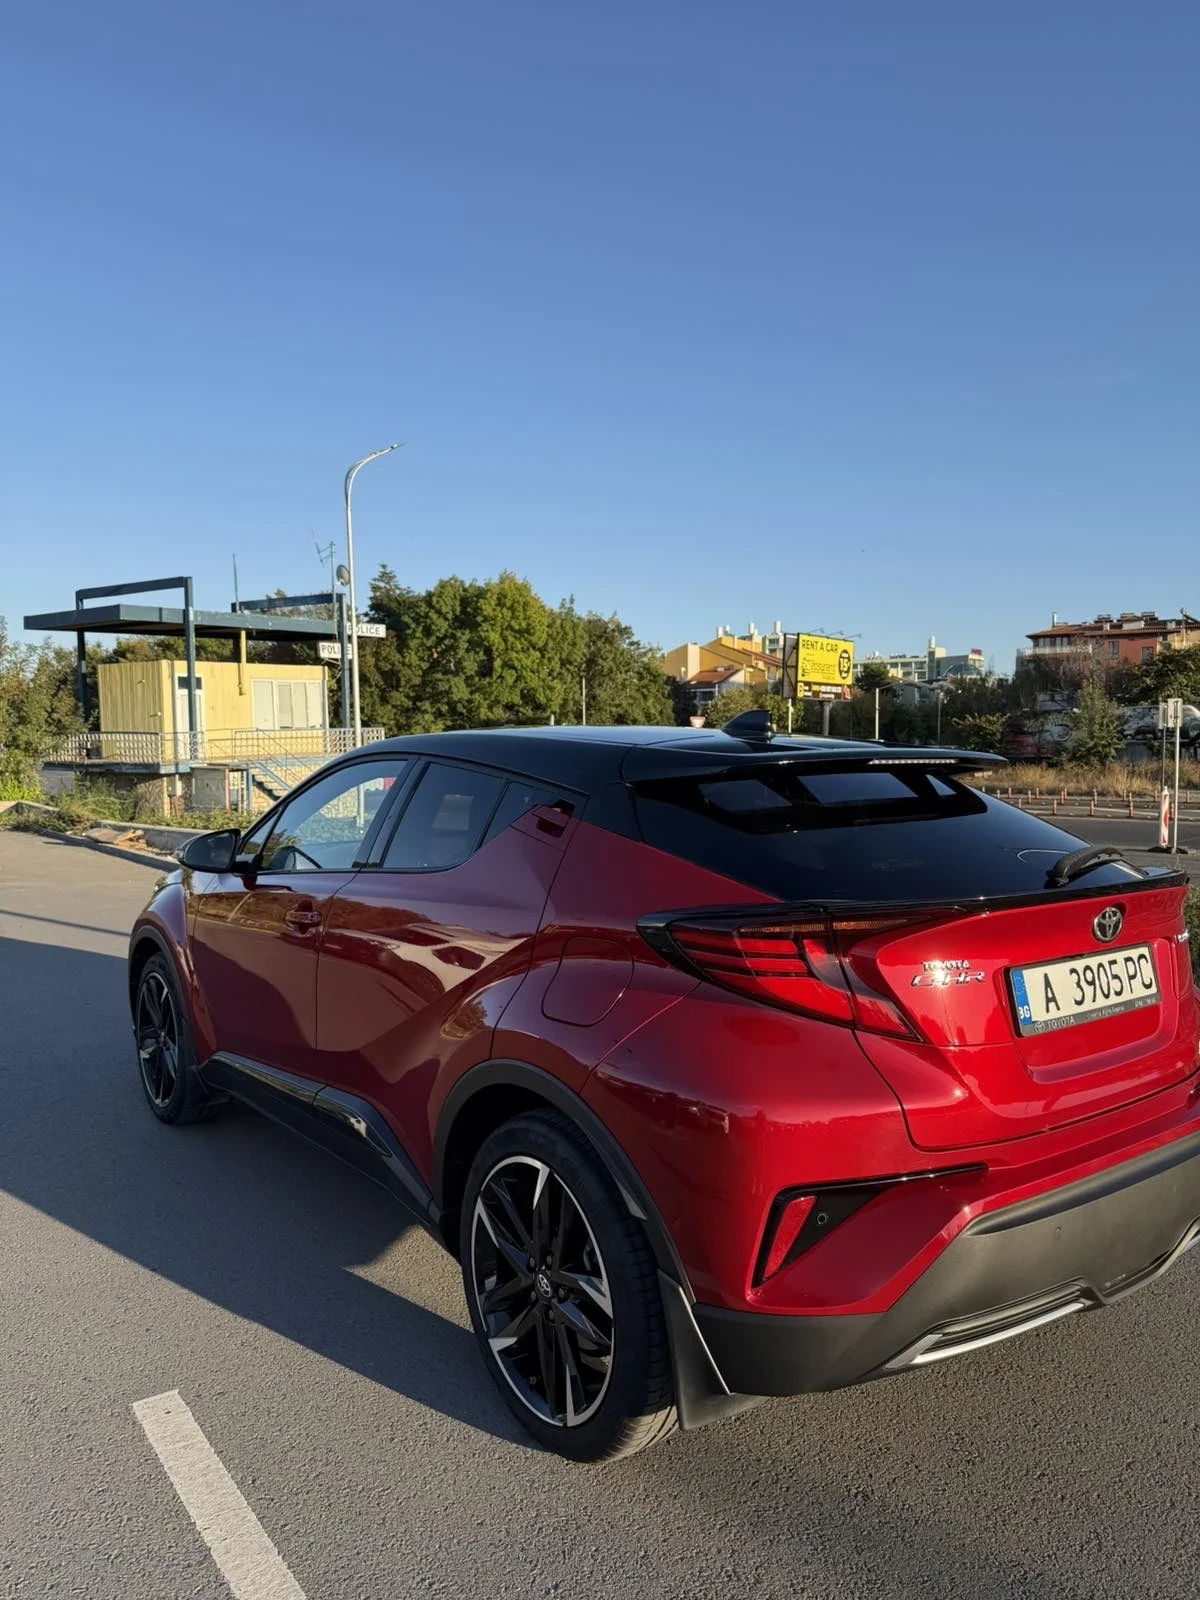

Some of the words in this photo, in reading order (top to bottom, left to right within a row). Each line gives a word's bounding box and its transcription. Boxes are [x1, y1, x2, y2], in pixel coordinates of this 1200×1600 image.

[321, 644, 351, 655] POLIE
[801, 639, 818, 650] RENT
[820, 642, 825, 651] A
[826, 642, 839, 653] CAR
[1043, 972, 1061, 1014] A
[1069, 960, 1124, 1006] 3905
[1123, 953, 1153, 994] PC
[1047, 1016, 1076, 1030] TOYOTA
